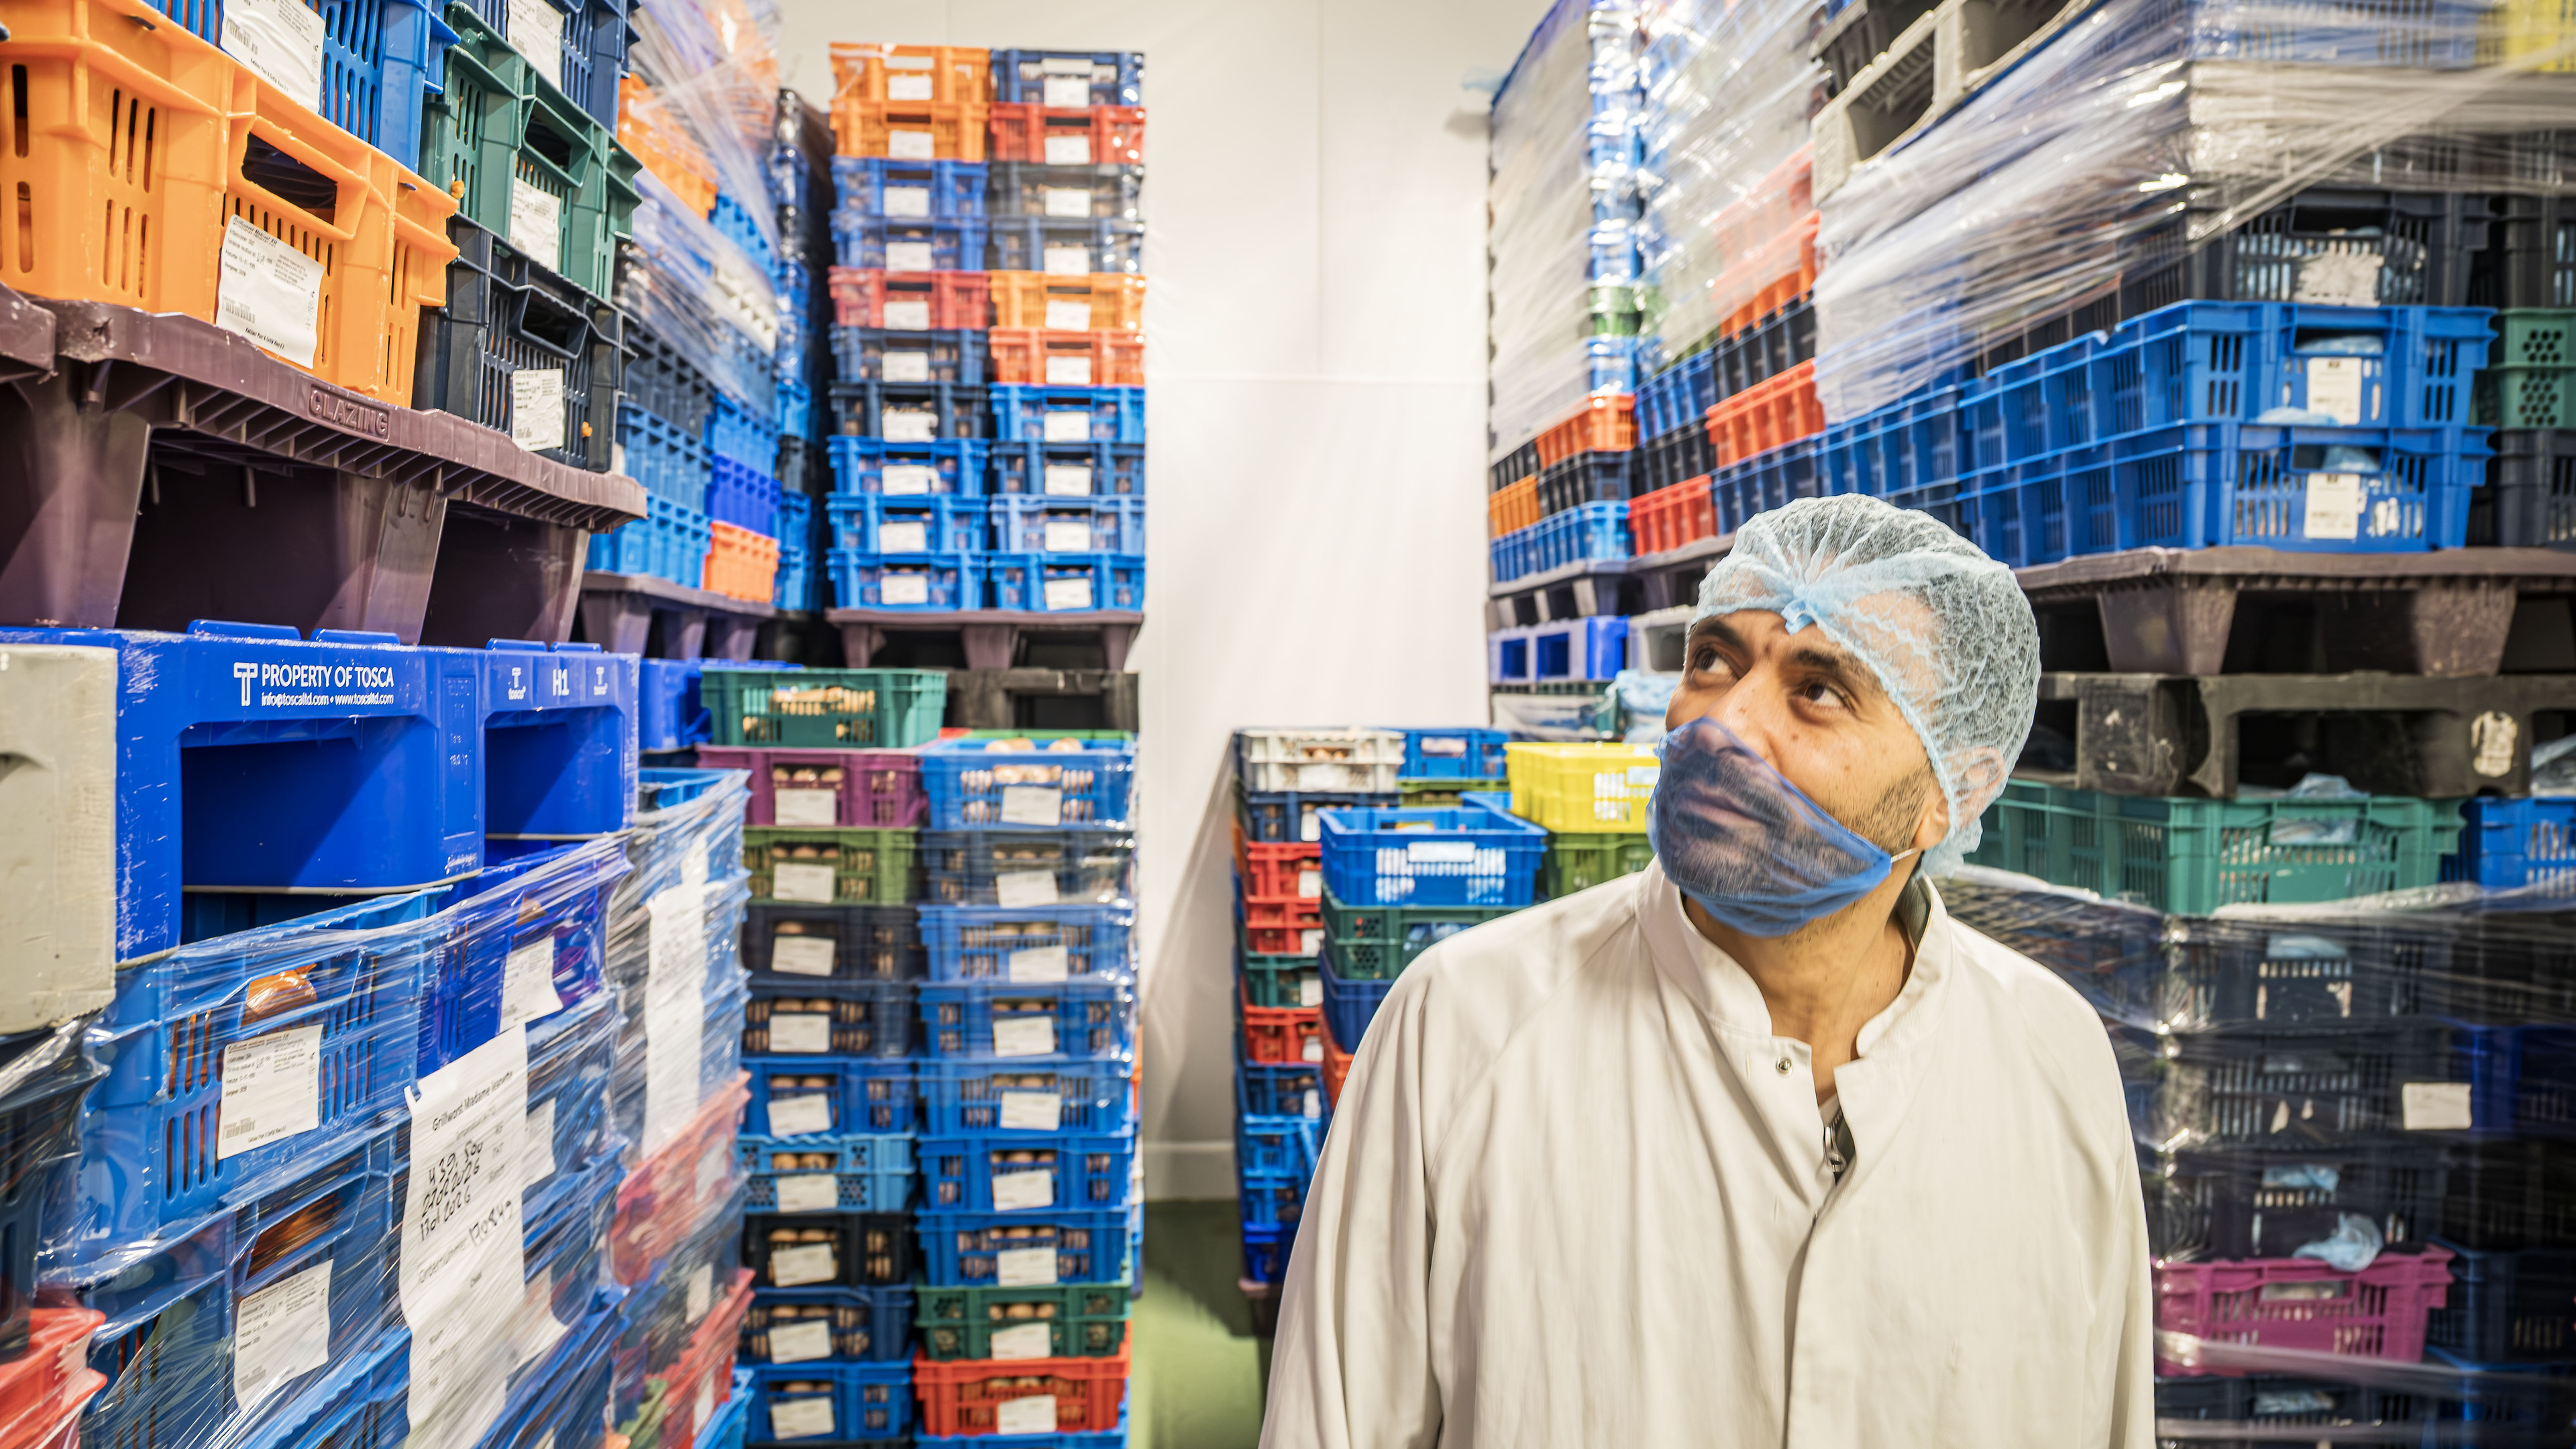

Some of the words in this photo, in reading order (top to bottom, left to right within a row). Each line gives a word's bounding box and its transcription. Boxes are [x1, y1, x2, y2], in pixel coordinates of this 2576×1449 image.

[262, 663, 332, 688] PROPERTY
[334, 666, 353, 688] OF
[354, 667, 394, 688] TOSCA
[553, 669, 570, 696] H1
